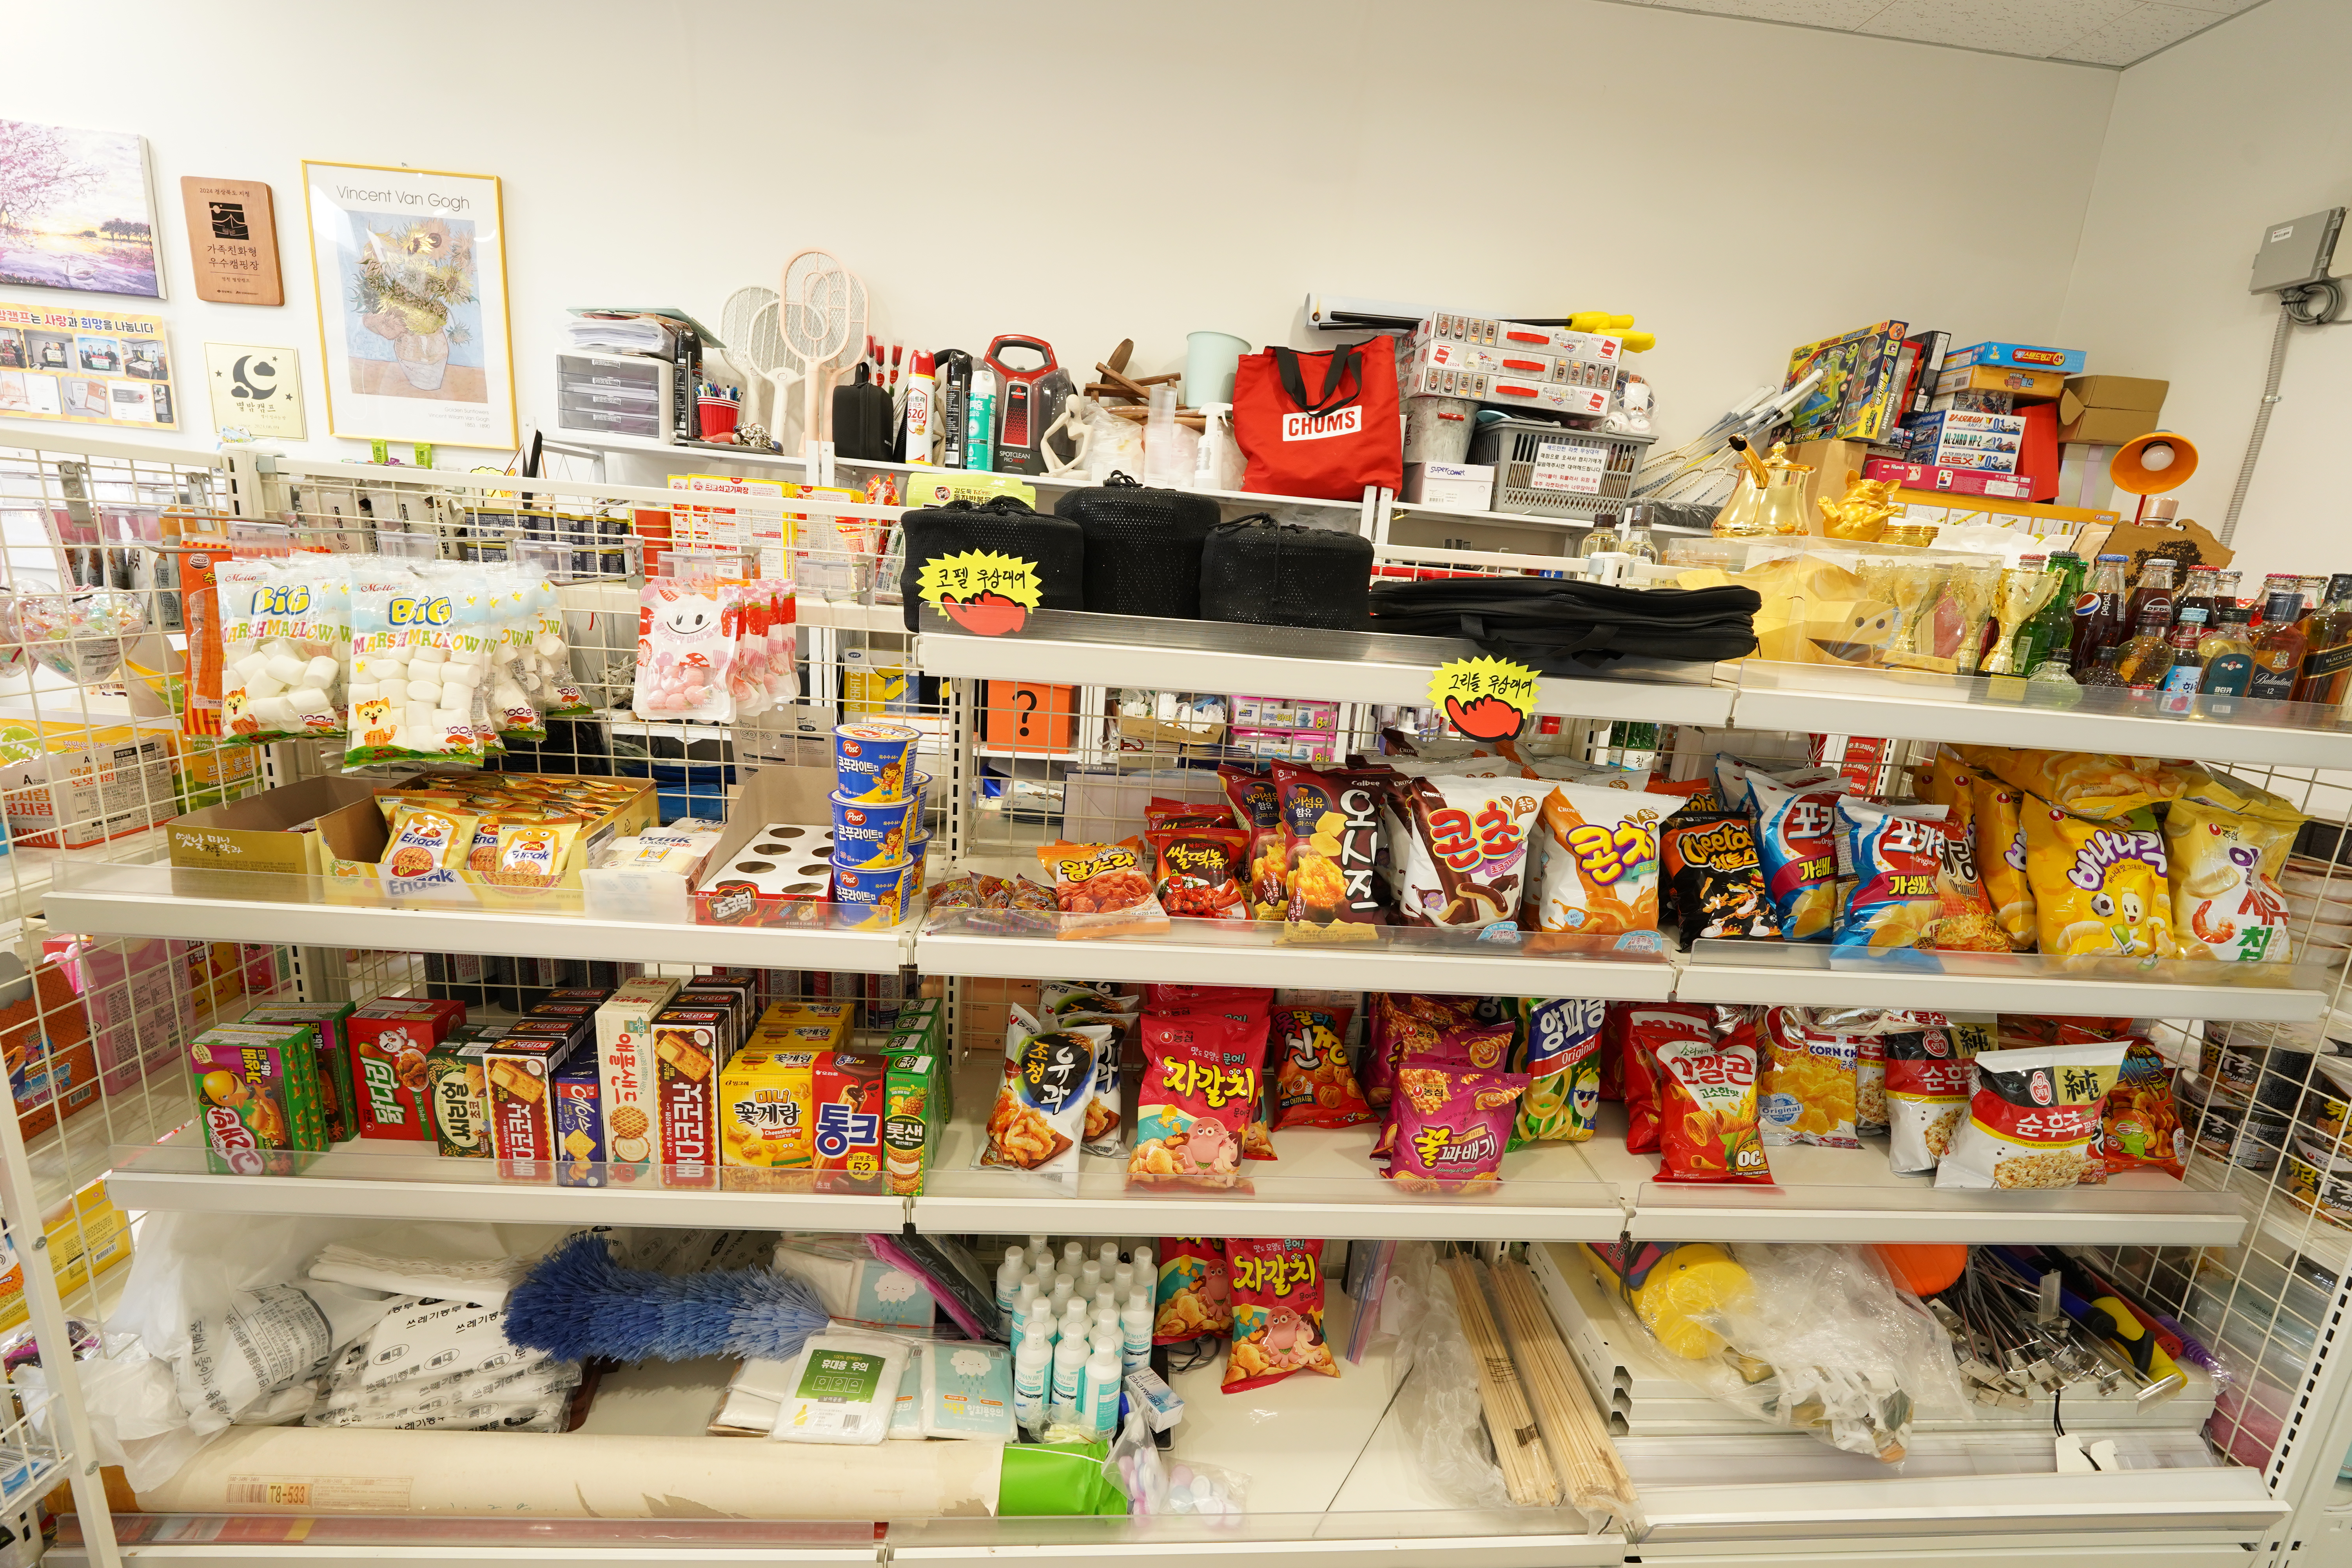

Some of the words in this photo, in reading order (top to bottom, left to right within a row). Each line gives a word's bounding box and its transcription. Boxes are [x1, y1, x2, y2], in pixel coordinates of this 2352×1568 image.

[337, 186, 391, 203] Vincent
[396, 190, 423, 206] Van
[428, 193, 470, 212] Gogh
[207, 244, 256, 257] 가족친화형
[209, 258, 259, 270] 우수캠핑장
[45, 314, 78, 327] 사랑과
[81, 317, 113, 330] 희망을
[115, 321, 153, 334] 나눕니다
[1893, 362, 1905, 392] MILITARY
[237, 401, 276, 413] 별밤캠프
[1881, 392, 1896, 430] EQUIPMENT
[1288, 410, 1357, 437] CHUMS
[1000, 451, 1030, 459] SPOTCLEAN
[718, 485, 749, 495] 쇠고기짜장
[936, 567, 968, 588] 코펠
[977, 568, 1025, 589] 무상대여
[220, 619, 334, 644] MARSHMALLOW
[354, 628, 480, 655] MARSHMALLOW
[655, 622, 685, 644] 딸기모양
[687, 624, 721, 644] 마시멜로
[1448, 672, 1481, 692] 그리들
[1488, 675, 1532, 699] 무상대여
[2254, 673, 2293, 687] Ballantine's
[503, 708, 533, 717] 100g
[446, 726, 474, 738] 100g
[844, 744, 859, 753] Post
[1854, 742, 1876, 753] 초코파이
[847, 813, 864, 822] Post
[1295, 808, 1313, 818] 함유
[176, 832, 205, 851] 옛날
[207, 835, 230, 845] 미니
[399, 832, 445, 848] Enaak
[1429, 799, 1524, 872] 콘초
[1060, 853, 1137, 882] 왕소라
[1798, 856, 1831, 881] 가성비
[1174, 1033, 1193, 1043] 농심
[1285, 1025, 1347, 1070] 신짱
[1561, 1041, 1596, 1067] Original
[1809, 1045, 1842, 1057] CORN
[240, 1048, 262, 1084] 가성비
[262, 1064, 271, 1077] 46g
[609, 1033, 637, 1104] 애플샌드
[1027, 1040, 1051, 1084] 조청
[1040, 1045, 1076, 1115] 유과
[1163, 1055, 1255, 1109] 자갈치
[2063, 1069, 2103, 1102] 純
[360, 1057, 405, 1125] 닭다리
[755, 1089, 791, 1103] 미니
[1424, 1087, 1444, 1097] 농심
[1699, 1087, 1740, 1099] 고소한맛
[441, 1082, 470, 1141] 씨리얼
[470, 1101, 481, 1118] 초코
[570, 1085, 595, 1134] 에이스
[734, 1102, 802, 1127] 꽃게랑
[1762, 1104, 1801, 1115] Original
[764, 1127, 802, 1136] CheeseBurger
[816, 1103, 880, 1158] 통크
[886, 1122, 923, 1142] 롯샌
[2016, 1110, 2086, 1138] 순후추
[1458, 1133, 1470, 1143] SINCE
[1470, 1129, 1481, 1138] 1972
[1232, 1252, 1316, 1298] 자갈치
[406, 1305, 461, 1328] 쓰레기봉투
[381, 1348, 402, 1361] 특대
[432, 1352, 453, 1366] 특대
[821, 1359, 848, 1370] 휴대용
[851, 1361, 869, 1372] 우의
[366, 1364, 420, 1394] 쓰레기봉투
[944, 1403, 964, 1415] 아동용
[967, 1406, 1004, 1417] 일회용우의
[270, 1485, 305, 1503] T8-533
